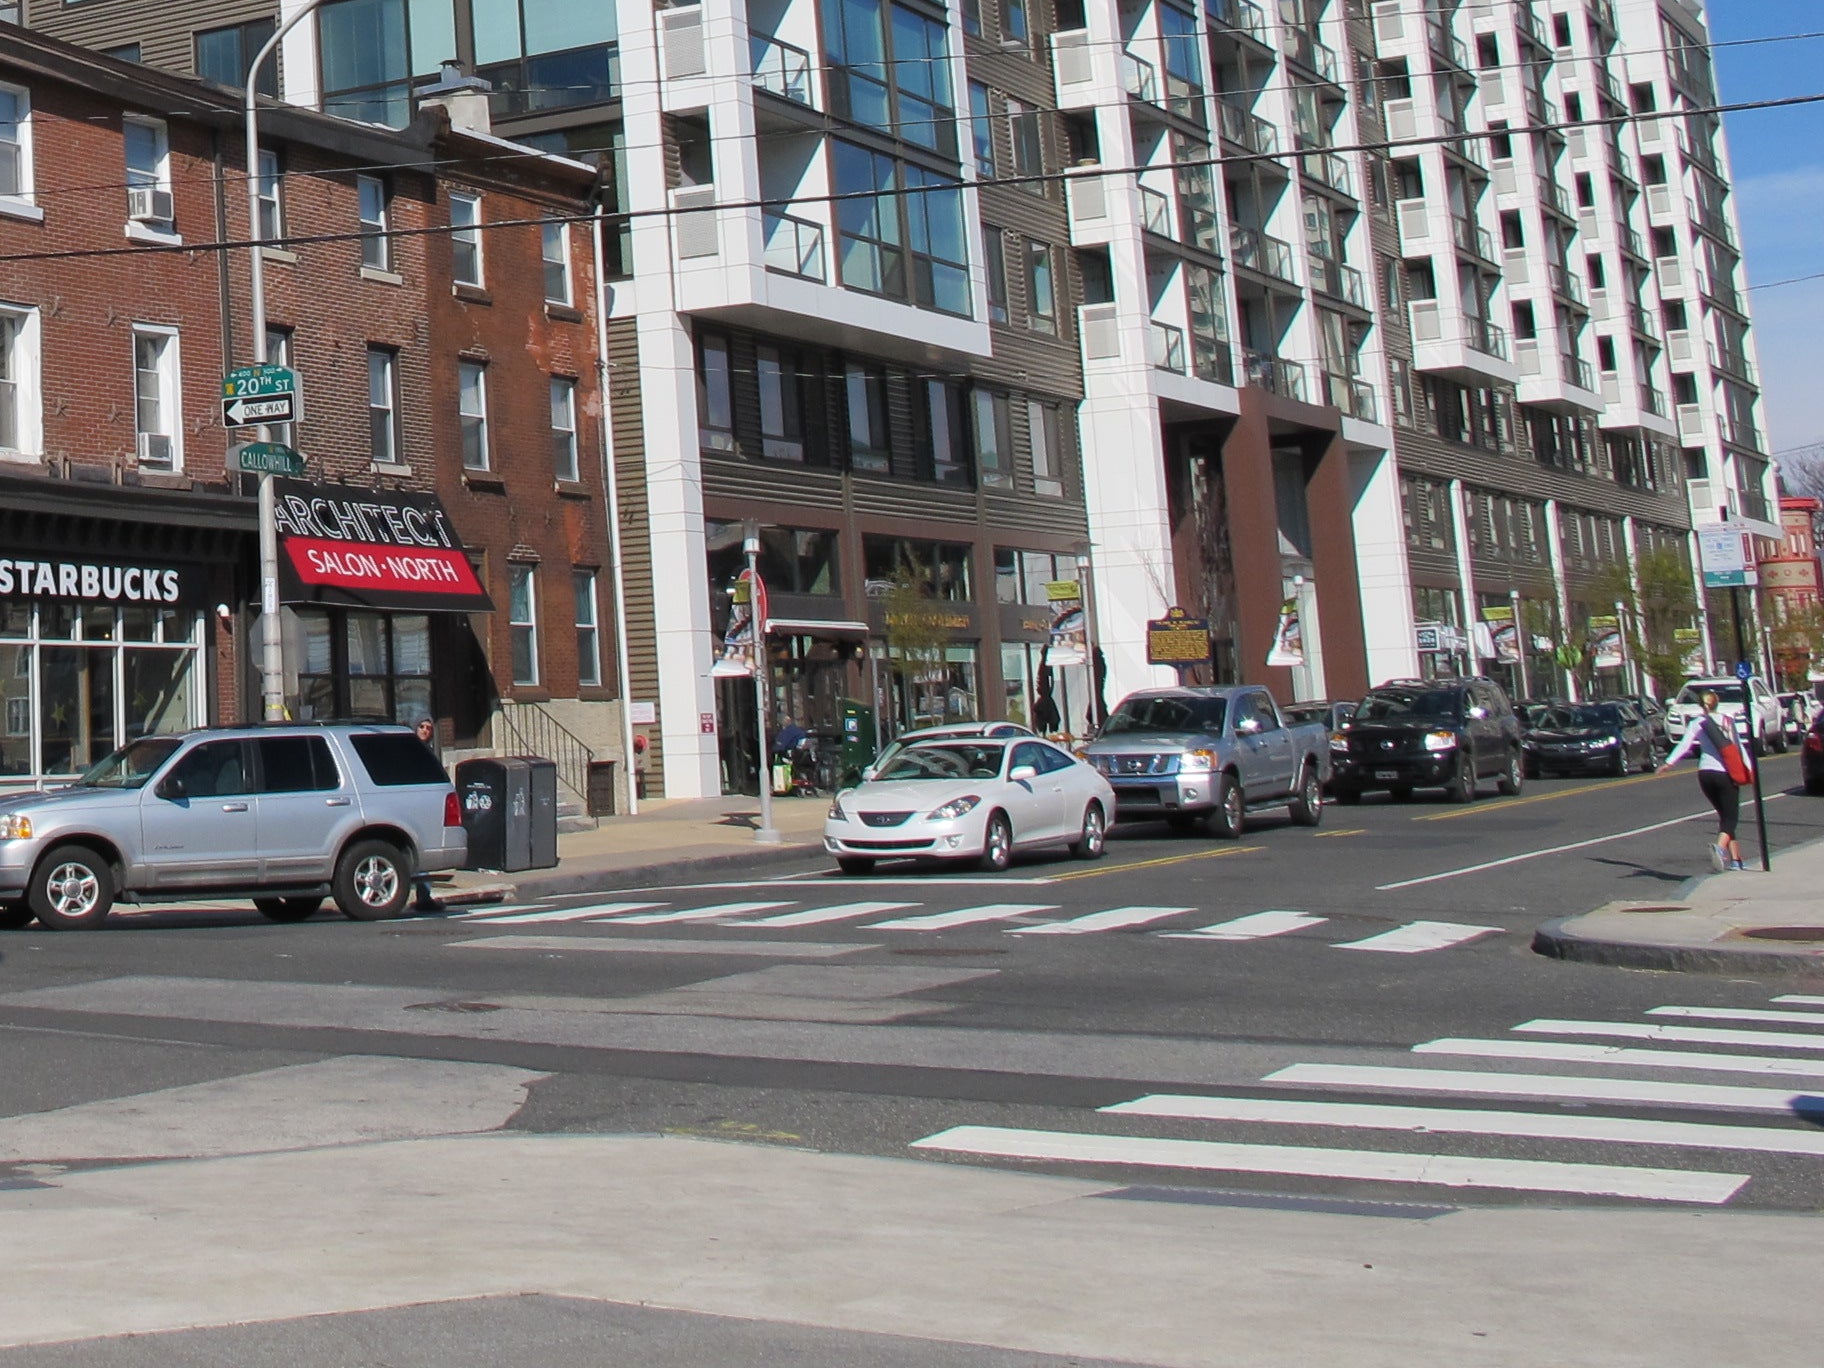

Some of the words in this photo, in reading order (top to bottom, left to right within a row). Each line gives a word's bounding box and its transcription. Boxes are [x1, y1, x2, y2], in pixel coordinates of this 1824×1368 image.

[237, 376, 272, 395] 20TH
[275, 379, 289, 391] ST
[244, 405, 264, 417] ONE
[265, 402, 286, 414] WAY
[241, 451, 291, 472] CALLOWHILL
[274, 494, 452, 548] ARCHITECT
[307, 549, 382, 578] SALON
[386, 556, 459, 582] NORTH
